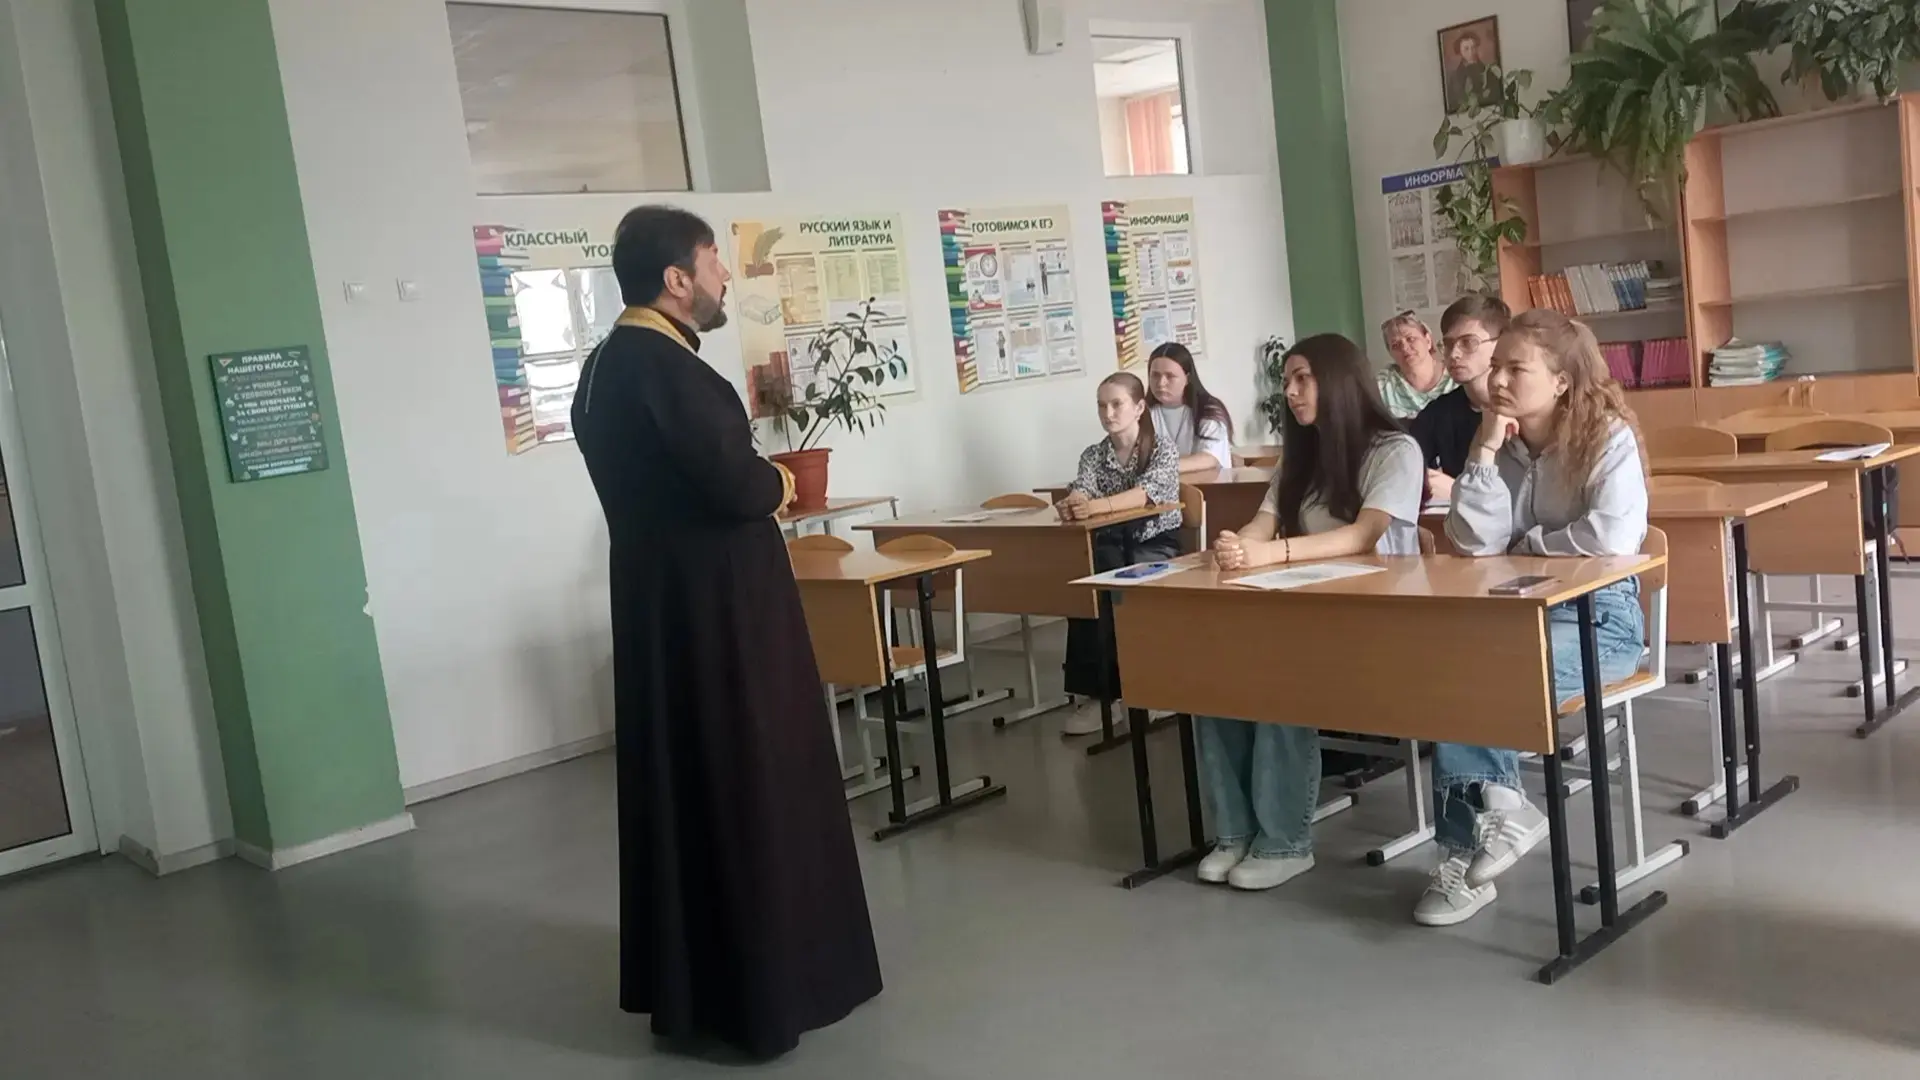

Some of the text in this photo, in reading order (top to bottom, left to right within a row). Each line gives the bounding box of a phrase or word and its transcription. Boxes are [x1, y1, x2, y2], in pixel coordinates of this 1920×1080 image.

[1405, 168, 1464, 187] ИНФОРМА
[799, 217, 892, 234] РУССКИЙ ЯЗЫК И
[971, 218, 1053, 233] ГОТОВИМСЯ К ЕГЭ
[1129, 213, 1189, 226] ИНФОРМАЦИЯ
[504, 228, 588, 246] КЛАССНЫЙ
[828, 233, 893, 247] ЛИТЕРАТУРА
[241, 352, 281, 363] ПРАВИЛА
[227, 359, 299, 374] НАШЕГО КЛАССА
